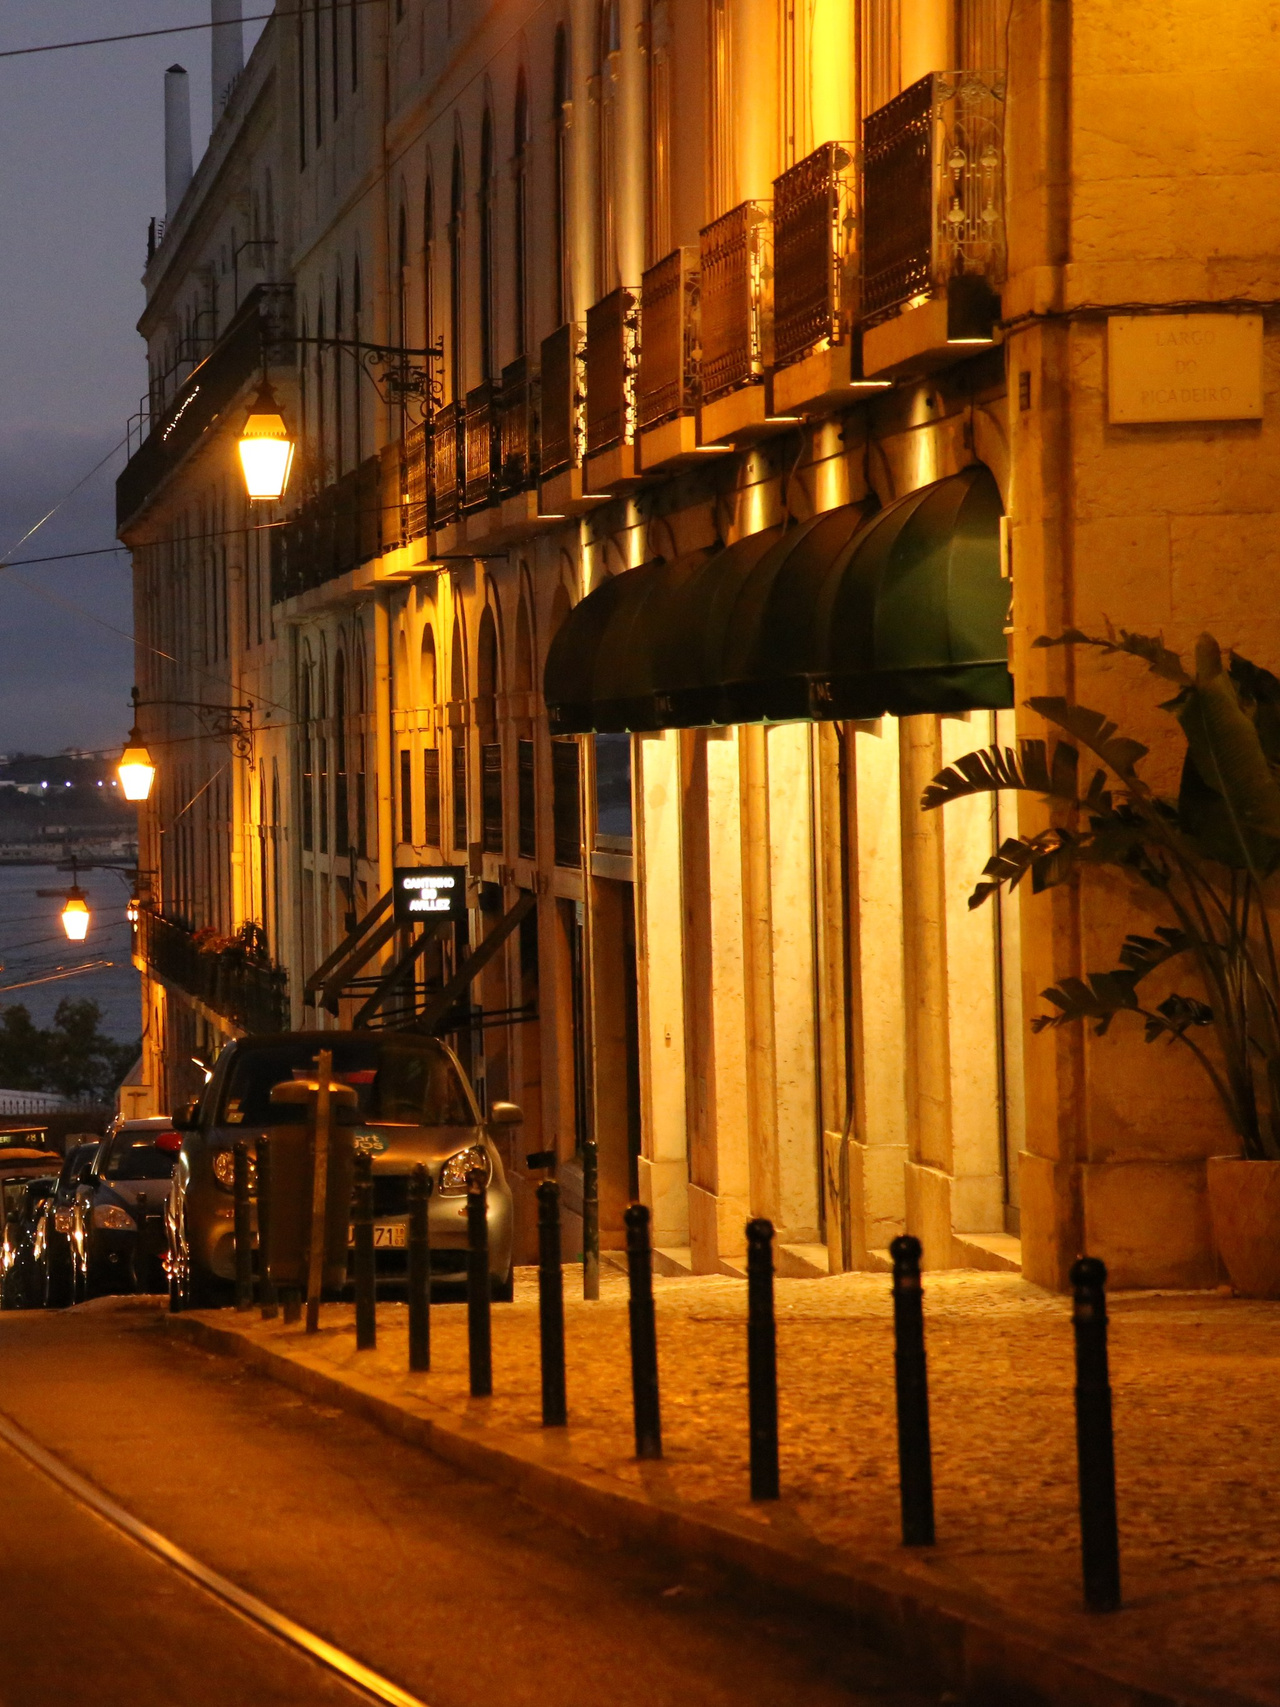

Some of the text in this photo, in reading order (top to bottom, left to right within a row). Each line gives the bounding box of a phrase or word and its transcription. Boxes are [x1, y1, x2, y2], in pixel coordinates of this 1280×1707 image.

[1155, 330, 1215, 347] LARGO
[1175, 360, 1197, 375] DO
[1141, 386, 1232, 404] PICADEIRO
